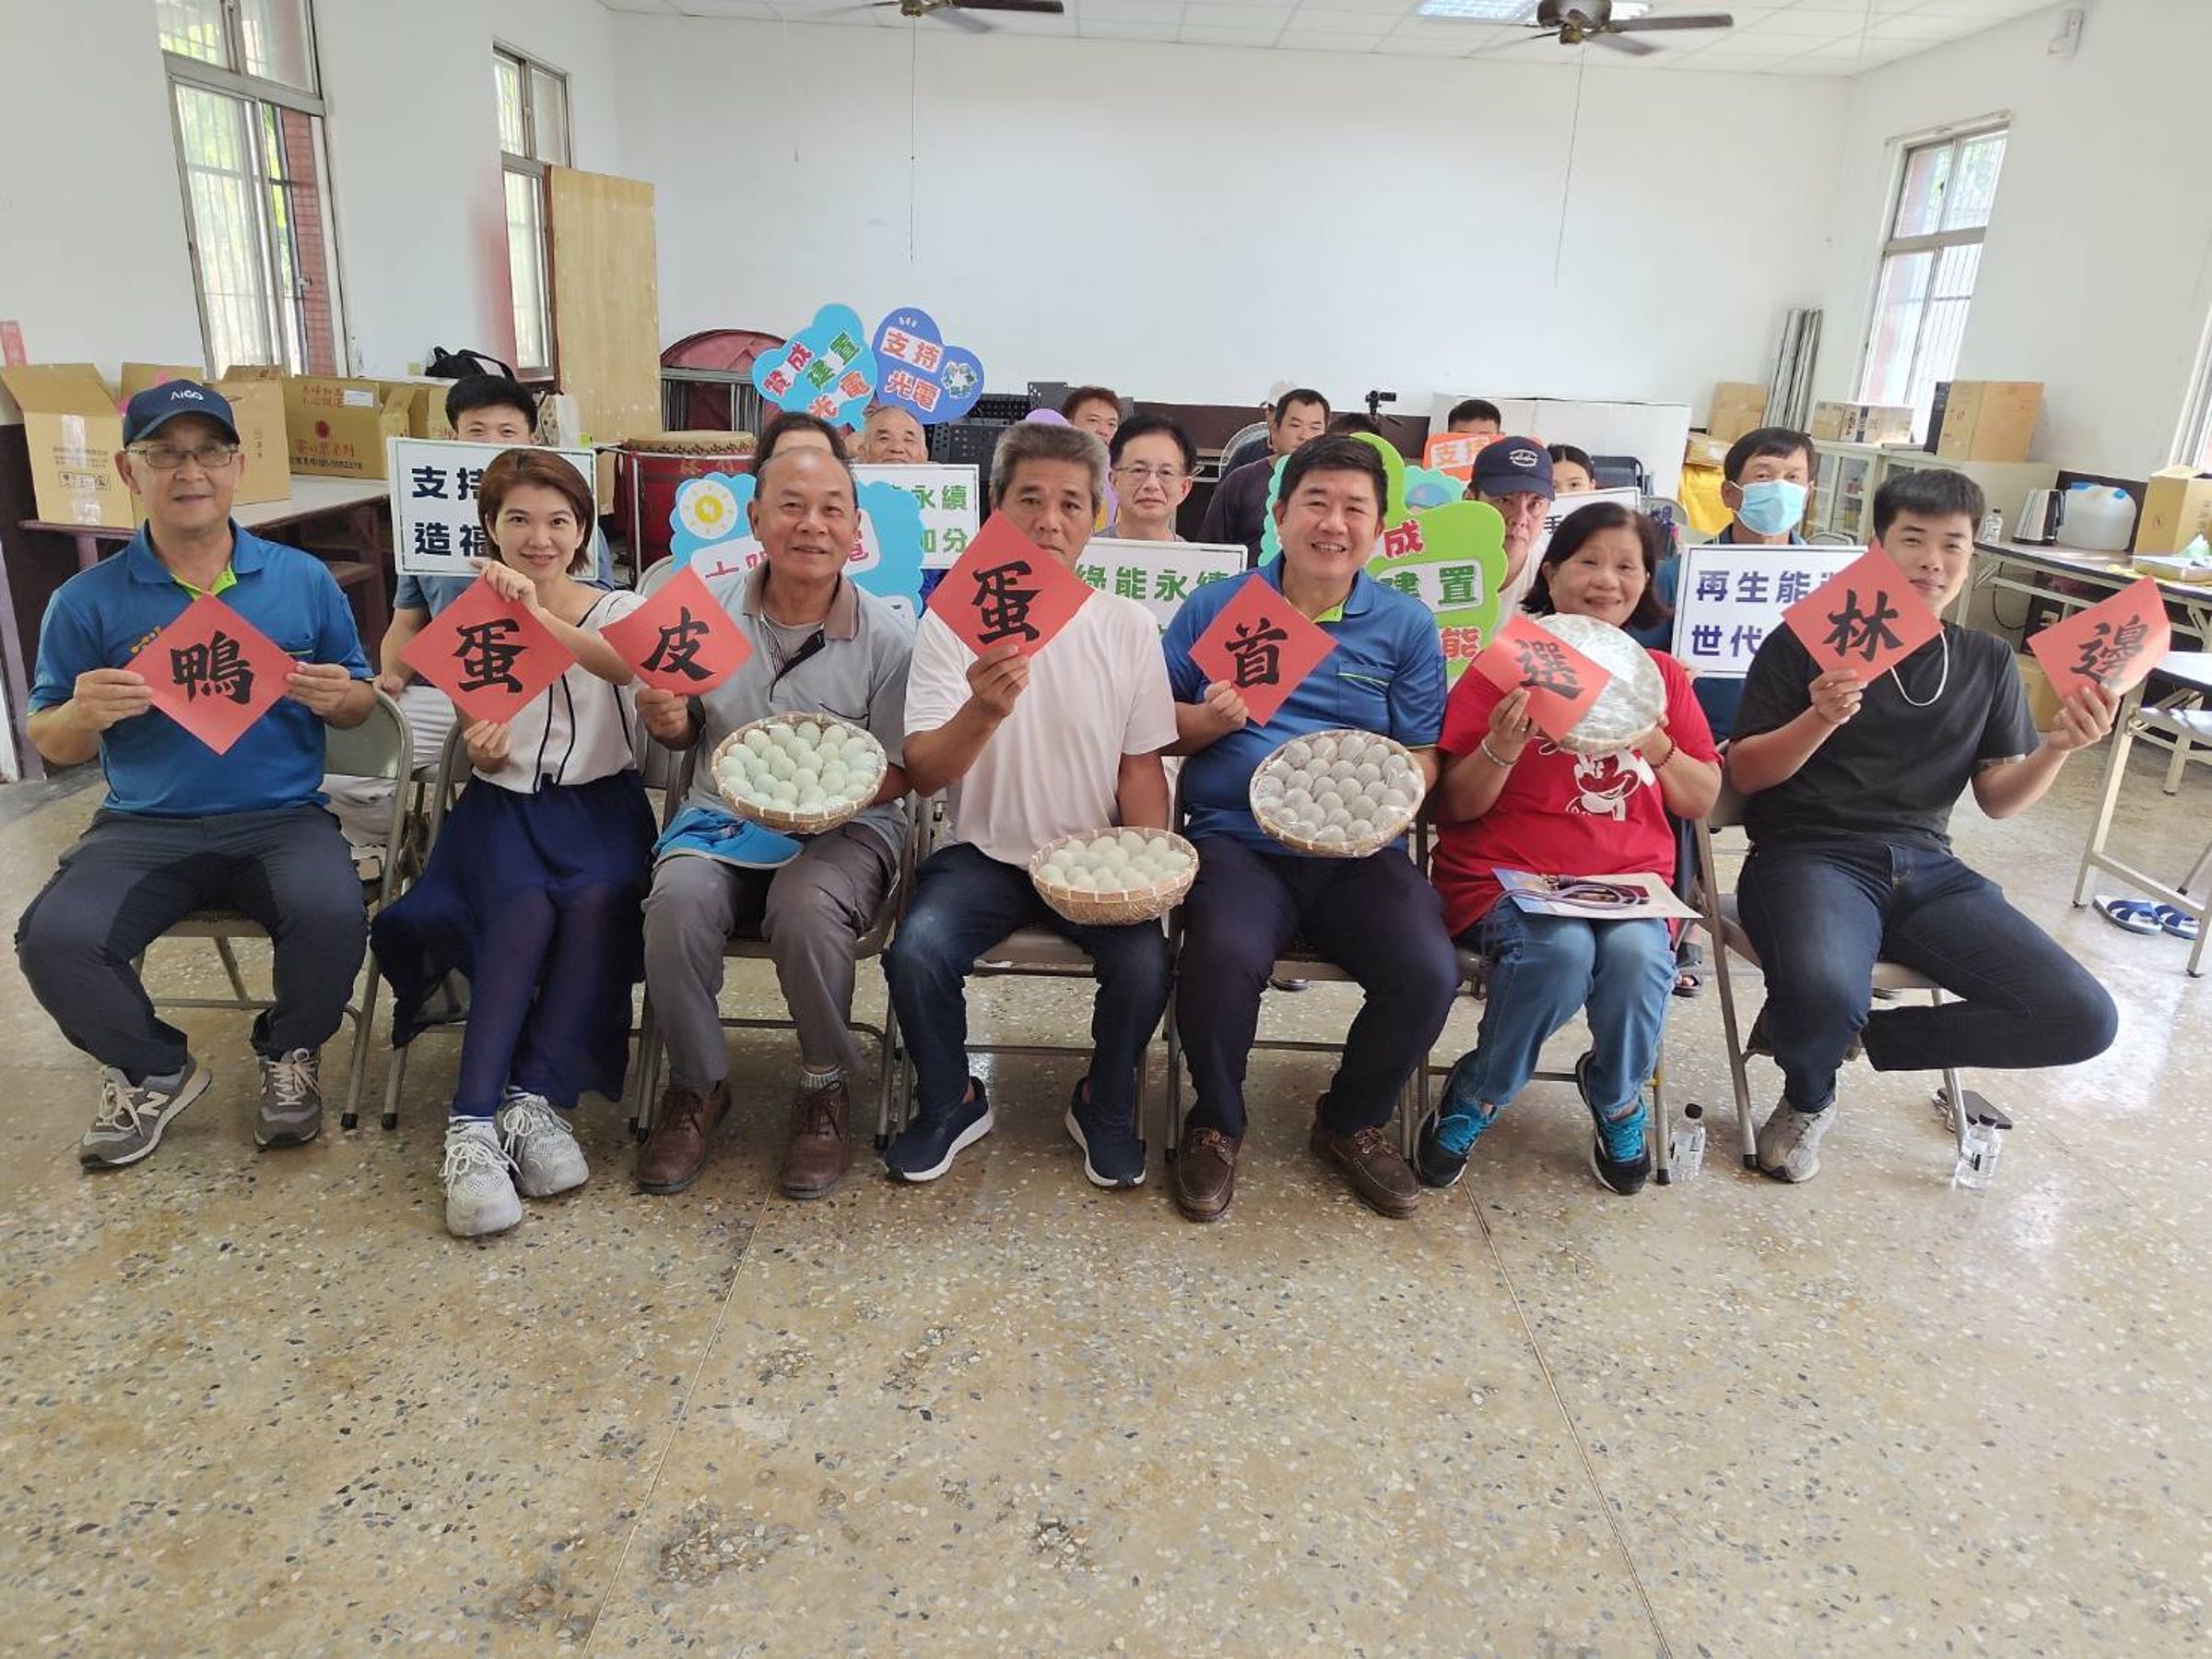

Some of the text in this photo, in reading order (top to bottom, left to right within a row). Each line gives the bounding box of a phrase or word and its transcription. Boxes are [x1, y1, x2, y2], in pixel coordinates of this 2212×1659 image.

[806, 332, 861, 389] 建置
[882, 331, 940, 371] 支持
[808, 371, 871, 418] 光電
[886, 371, 938, 411] 光電
[890, 485, 968, 510] 永續
[414, 522, 491, 558] 造福
[1383, 519, 1424, 559] 成
[971, 560, 1041, 645] 蛋
[1696, 570, 1834, 604] 再生能
[639, 606, 716, 683] 皮
[1691, 624, 1762, 658] 世代
[1823, 589, 1904, 662] 林
[170, 629, 254, 705] 鴨
[453, 618, 528, 694] 蛋
[1224, 618, 1288, 688] 首
[1514, 639, 1583, 700] 選
